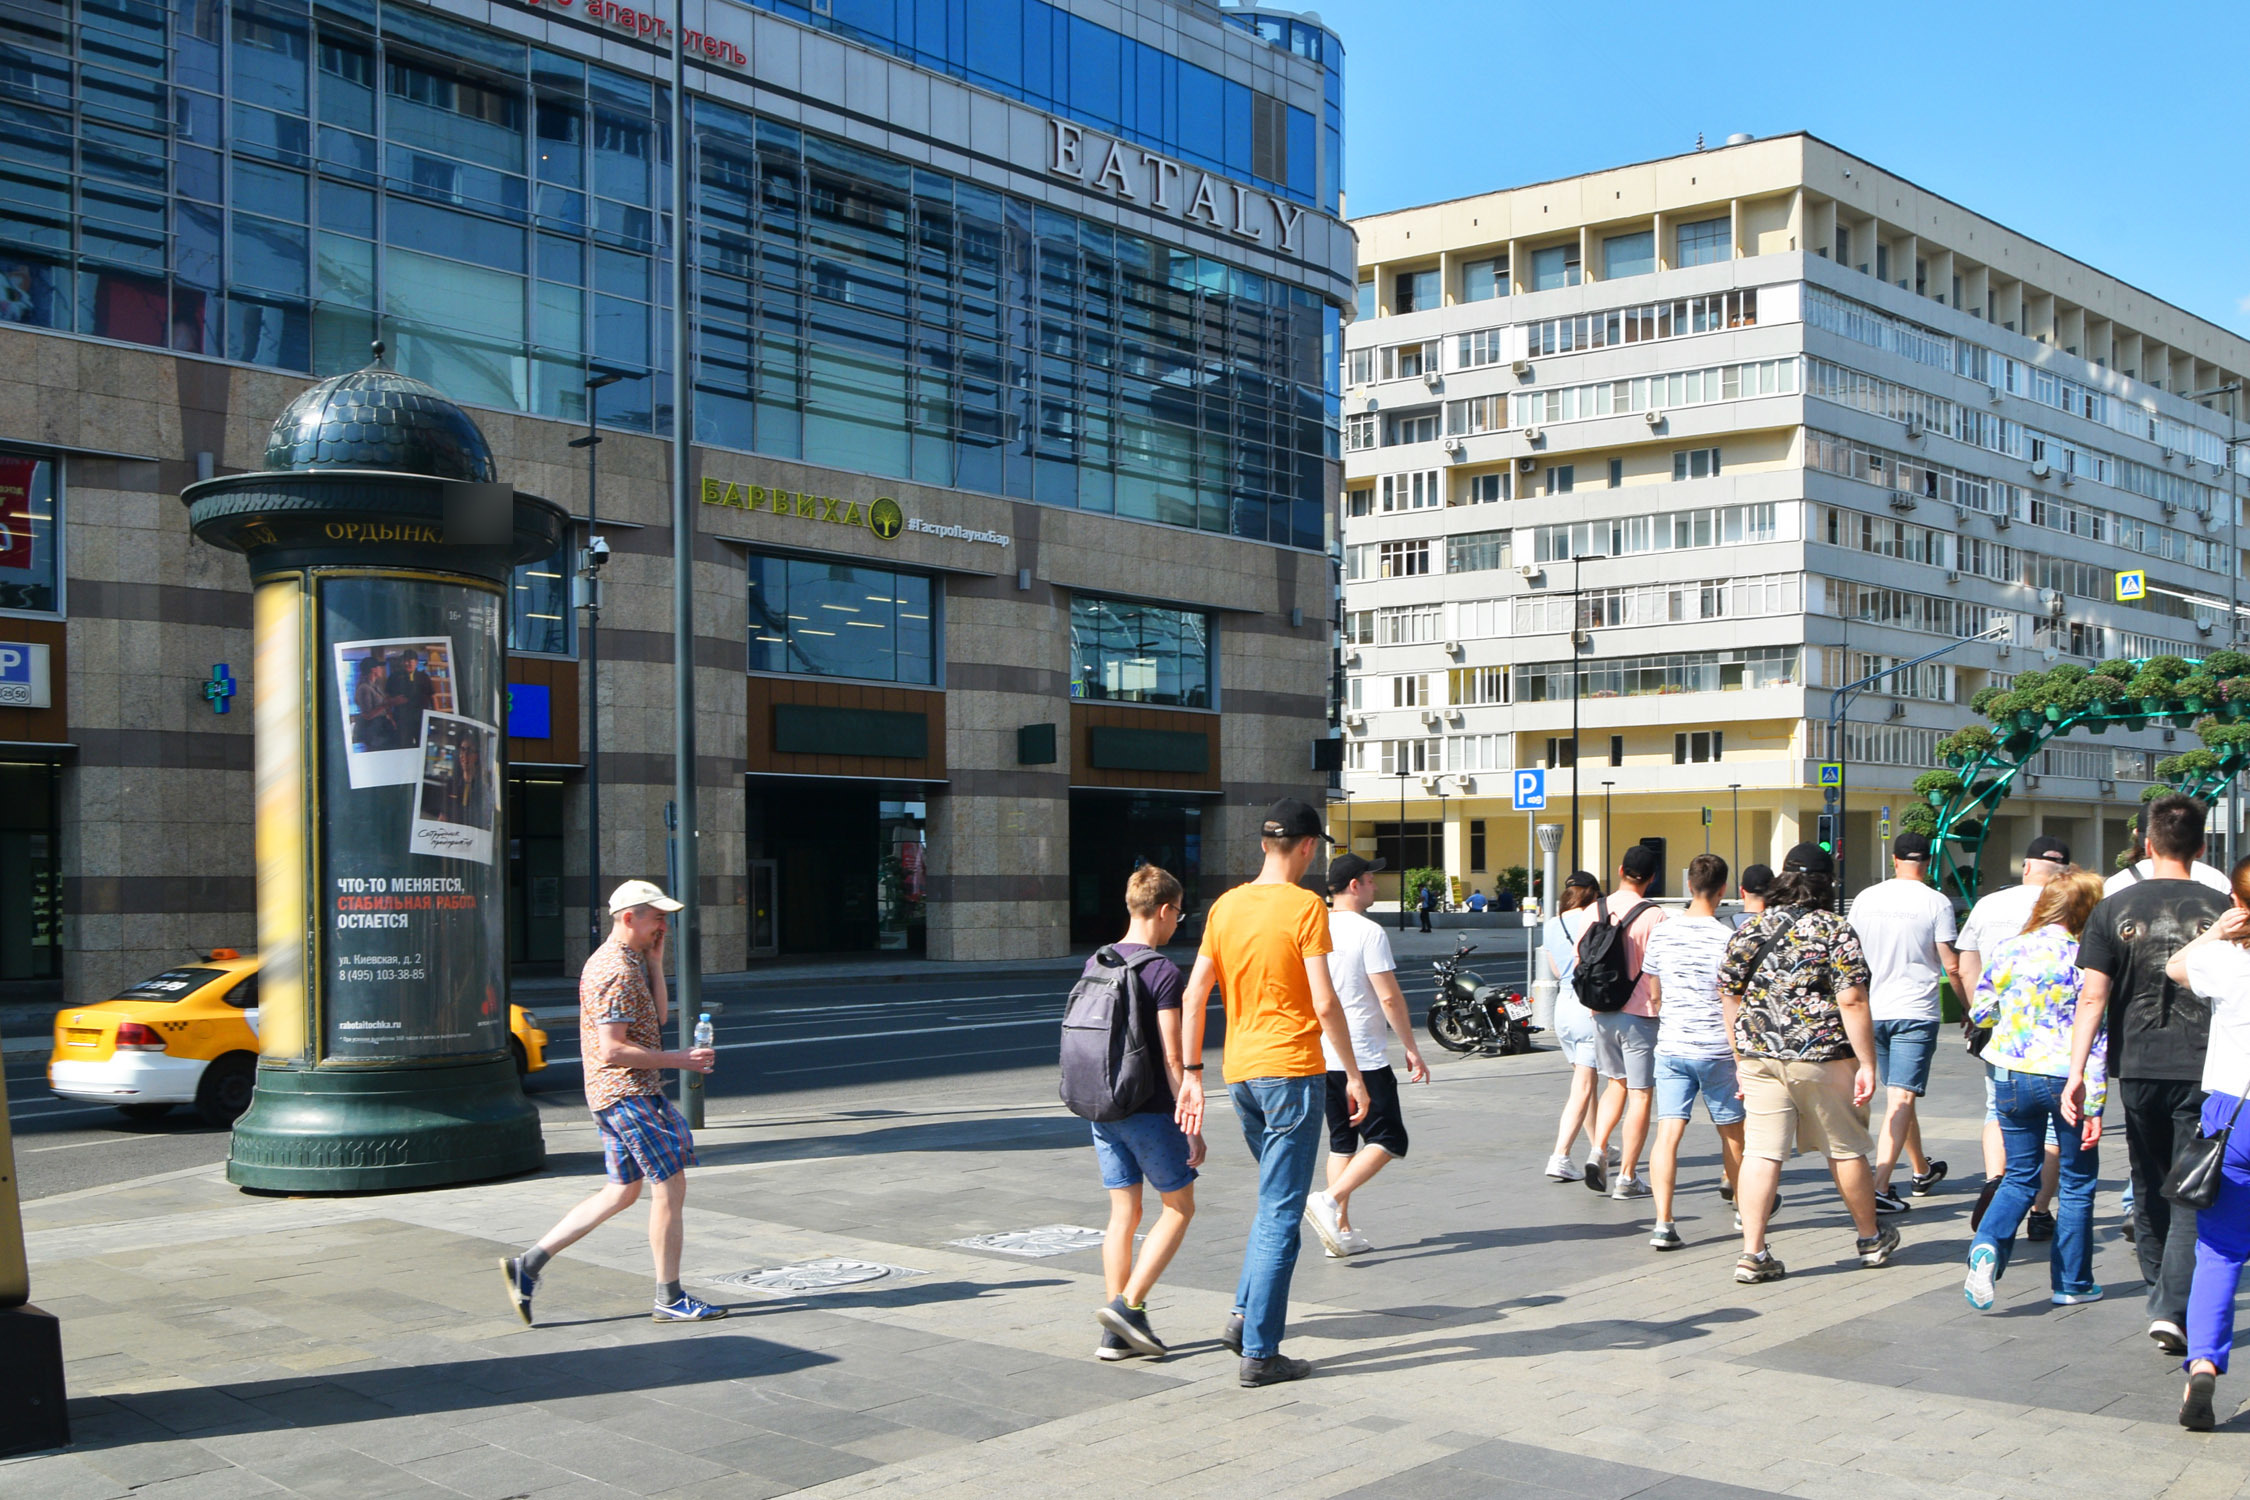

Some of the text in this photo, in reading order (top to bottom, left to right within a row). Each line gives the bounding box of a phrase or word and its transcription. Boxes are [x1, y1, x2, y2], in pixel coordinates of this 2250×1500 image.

[1050, 119, 1305, 251] EATALY
[702, 476, 864, 526] БАРВИХА
[325, 522, 443, 544] ОРДЫНК
[15, 690, 26, 698] 50
[1518, 773, 1537, 805] P
[337, 877, 465, 894] ЧТО-ТО МЕНЯЕТСЯ,
[337, 895, 476, 911] СТАБИЛЬНАЯ РАБОТА
[337, 913, 409, 929] ОСТАЕТСЯ
[338, 953, 421, 967] ул. Киевская, д. 2
[339, 969, 425, 982] 8 (495) 103-38-85
[339, 1020, 402, 1030] rabotaitochka.ru
